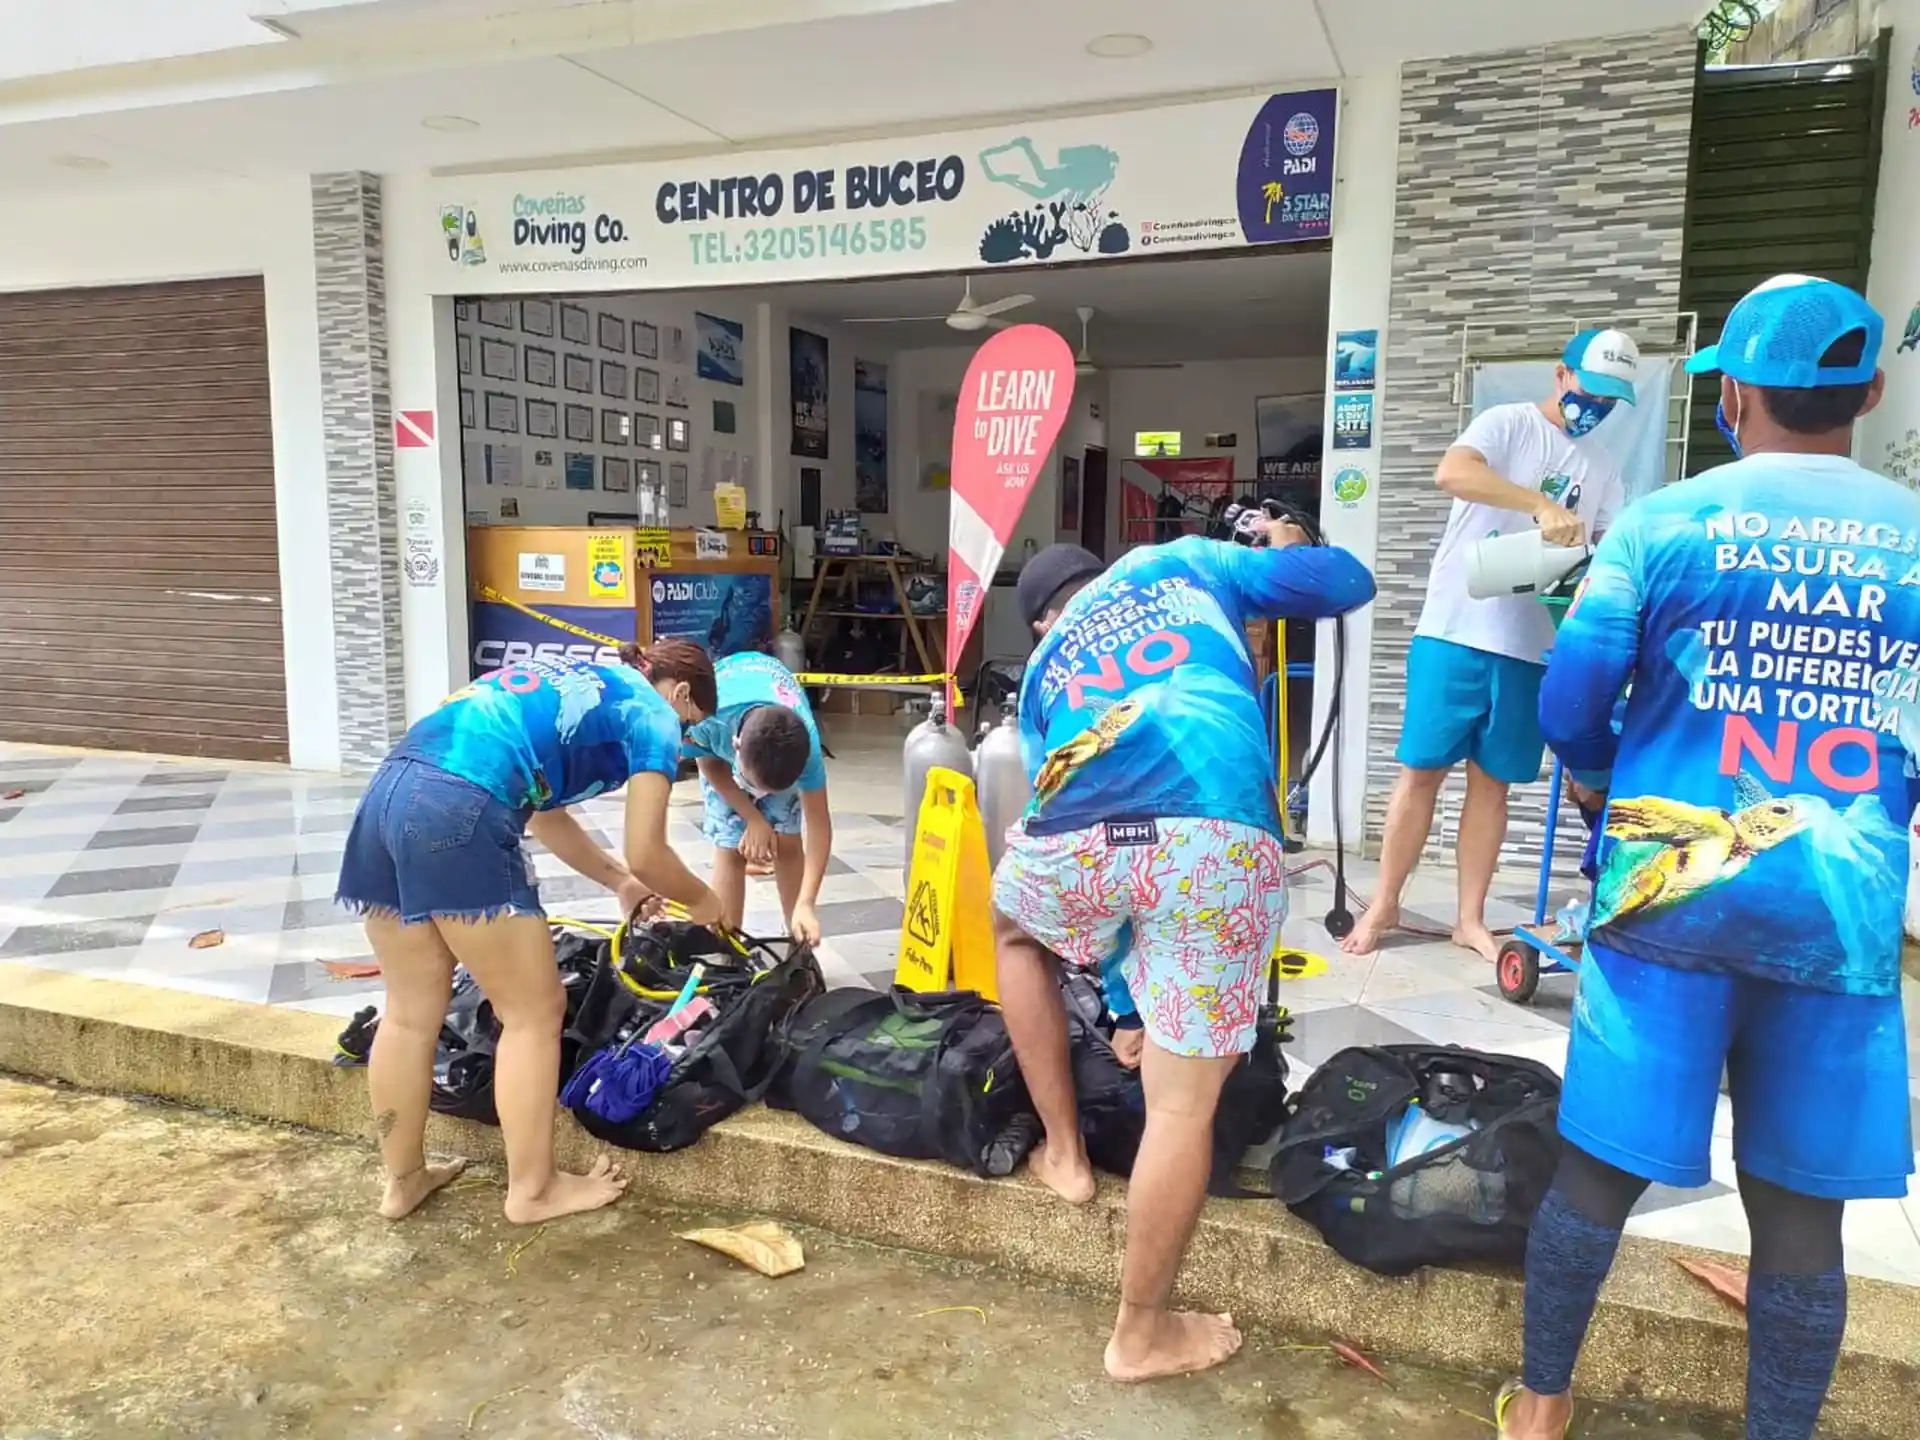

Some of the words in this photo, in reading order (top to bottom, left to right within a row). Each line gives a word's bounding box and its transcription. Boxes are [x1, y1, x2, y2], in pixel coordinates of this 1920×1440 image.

[1283, 157, 1317, 175] PADI
[656, 173, 784, 224] CENTRO
[793, 169, 835, 214] DE
[846, 155, 965, 210] BUCEO
[1283, 195, 1292, 213] 5
[1293, 193, 1330, 212] STAR
[514, 217, 586, 254] Diving
[594, 213, 629, 244] Co.
[689, 216, 927, 265] TEL:3205146585
[499, 256, 648, 274] www.covenasdiving.com
[976, 369, 1055, 412] LEARN
[974, 417, 988, 440] to
[987, 415, 1043, 457] DIVE
[1336, 420, 1368, 430] SITE
[1264, 462, 1286, 474] WE
[1706, 512, 1770, 541] NO
[1715, 541, 1887, 581] BASURA
[667, 582, 693, 600] PADI
[694, 580, 719, 600] Club
[1765, 577, 1887, 623] MAR
[1086, 606, 1202, 658] TORTUGA
[1700, 620, 1738, 646] TU
[1749, 621, 1871, 658] PUEDES
[1066, 630, 1190, 711] NO
[1703, 650, 1739, 677] LA
[1693, 682, 1764, 715] UNA
[1719, 714, 1880, 793] NO
